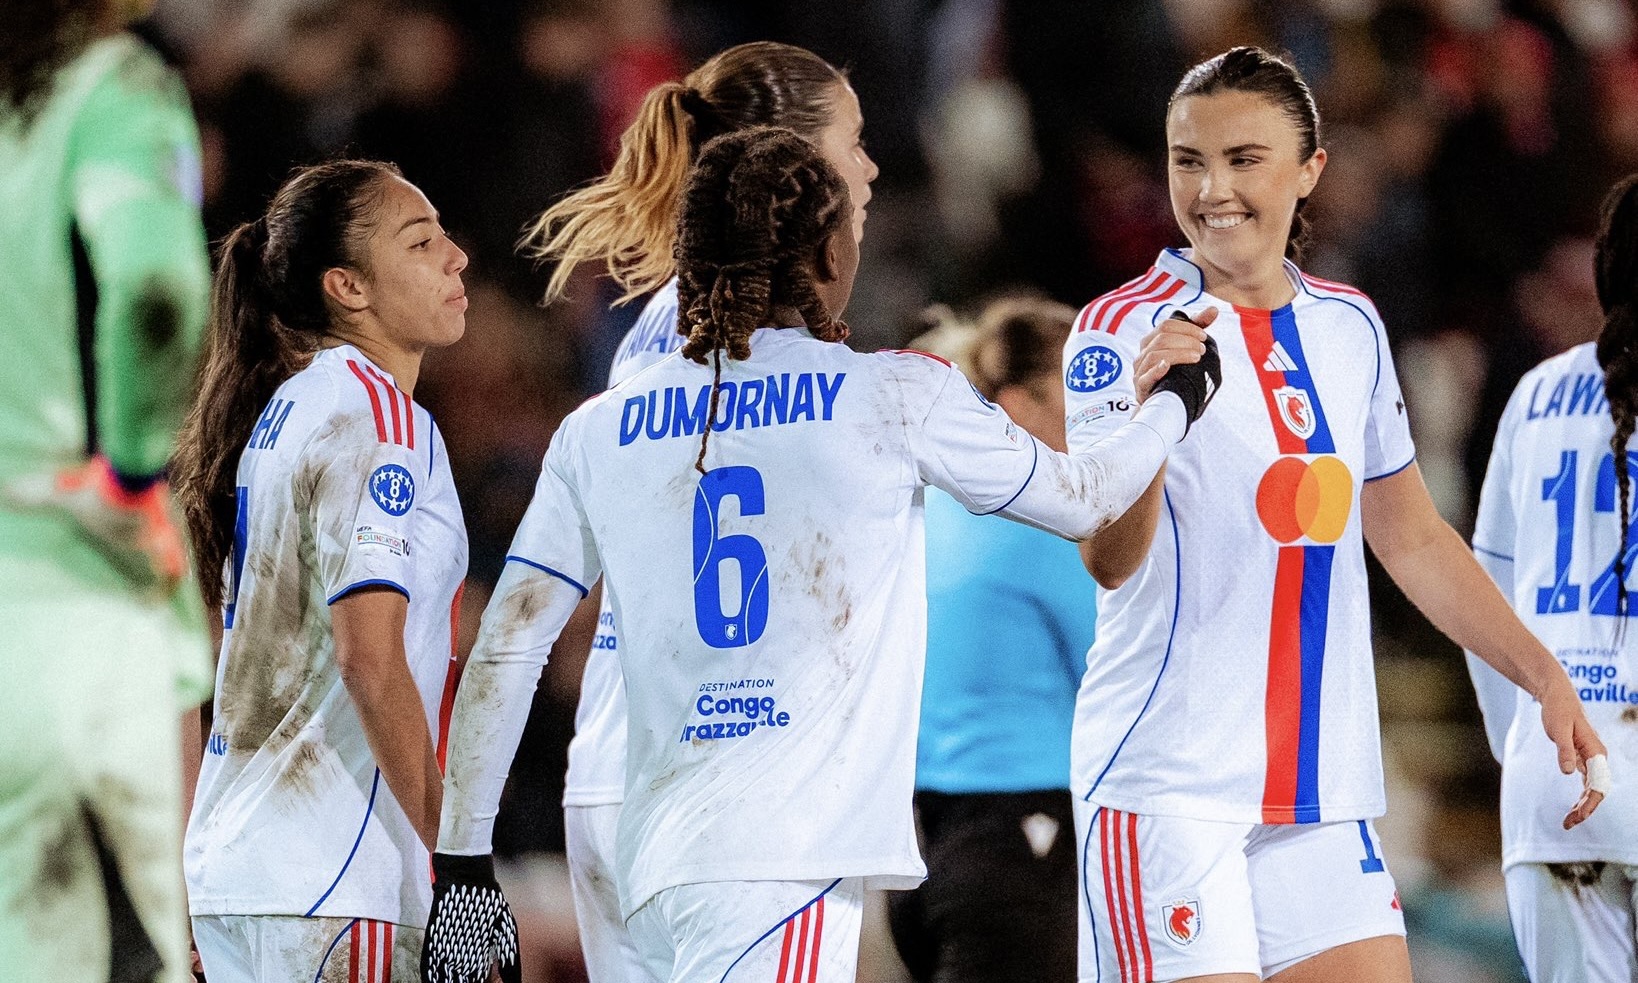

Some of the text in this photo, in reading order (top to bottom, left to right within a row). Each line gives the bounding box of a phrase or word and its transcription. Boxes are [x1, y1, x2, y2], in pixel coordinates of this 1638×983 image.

[1084, 358, 1098, 378] 8
[619, 372, 847, 447] DUMORNAY
[389, 478, 400, 498] 8
[1536, 449, 1638, 618] 12
[692, 465, 770, 650] 6
[1561, 659, 1617, 685] ongo
[698, 678, 775, 693] DESTINATION
[1575, 682, 1638, 705] aville
[696, 694, 776, 720] Congo
